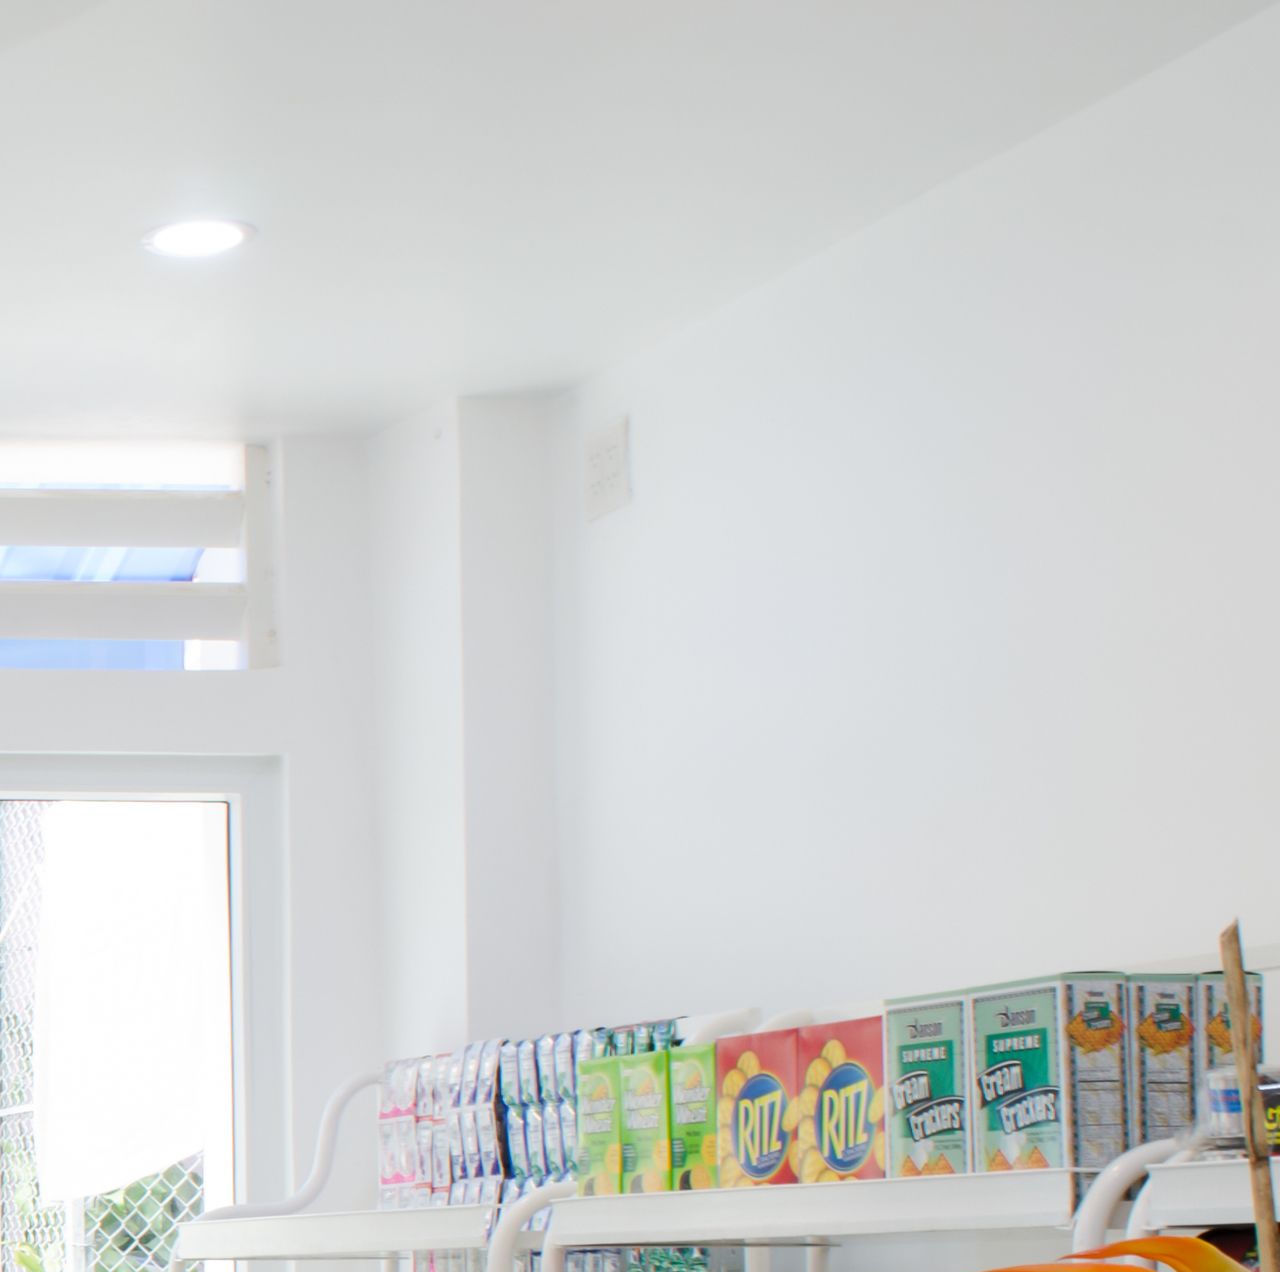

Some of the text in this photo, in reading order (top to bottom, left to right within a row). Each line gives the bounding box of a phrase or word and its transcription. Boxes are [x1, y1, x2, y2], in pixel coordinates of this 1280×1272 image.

[902, 1046, 948, 1064] SUPREME
[992, 1035, 1040, 1053] SUPREME
[980, 1065, 1023, 1102] Cream
[738, 1089, 783, 1166] RITZ
[822, 1079, 869, 1159] RITZ
